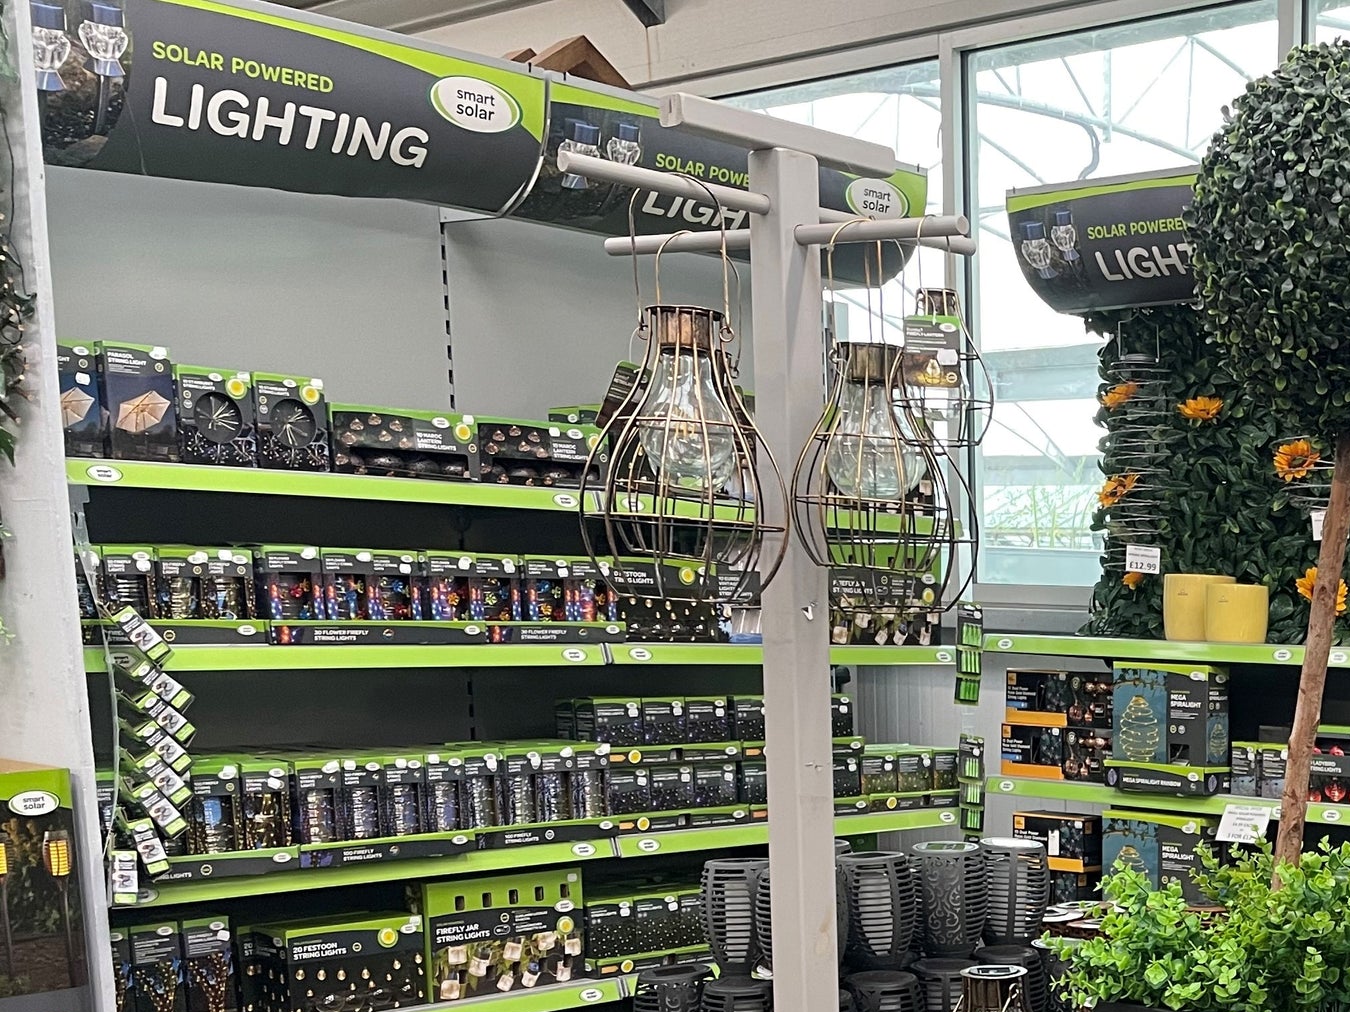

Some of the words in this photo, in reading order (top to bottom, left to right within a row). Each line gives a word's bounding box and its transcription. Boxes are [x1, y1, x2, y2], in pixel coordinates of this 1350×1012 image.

[152, 41, 225, 71] SOLAR
[231, 57, 334, 94] POWERED
[150, 77, 429, 168] LIGHTING
[1130, 561, 1156, 570] £12.99
[1170, 700, 1201, 709] SPIRALIGHT
[22, 795, 45, 803] smart
[436, 925, 464, 936] FIREFLY
[465, 923, 479, 932] JAR
[437, 932, 463, 943] STRING
[464, 929, 490, 938] LIGHTS
[293, 945, 302, 953] 20
[303, 942, 337, 952] FESTOON
[293, 948, 322, 960] STRING
[323, 947, 347, 956] LIGHTS
